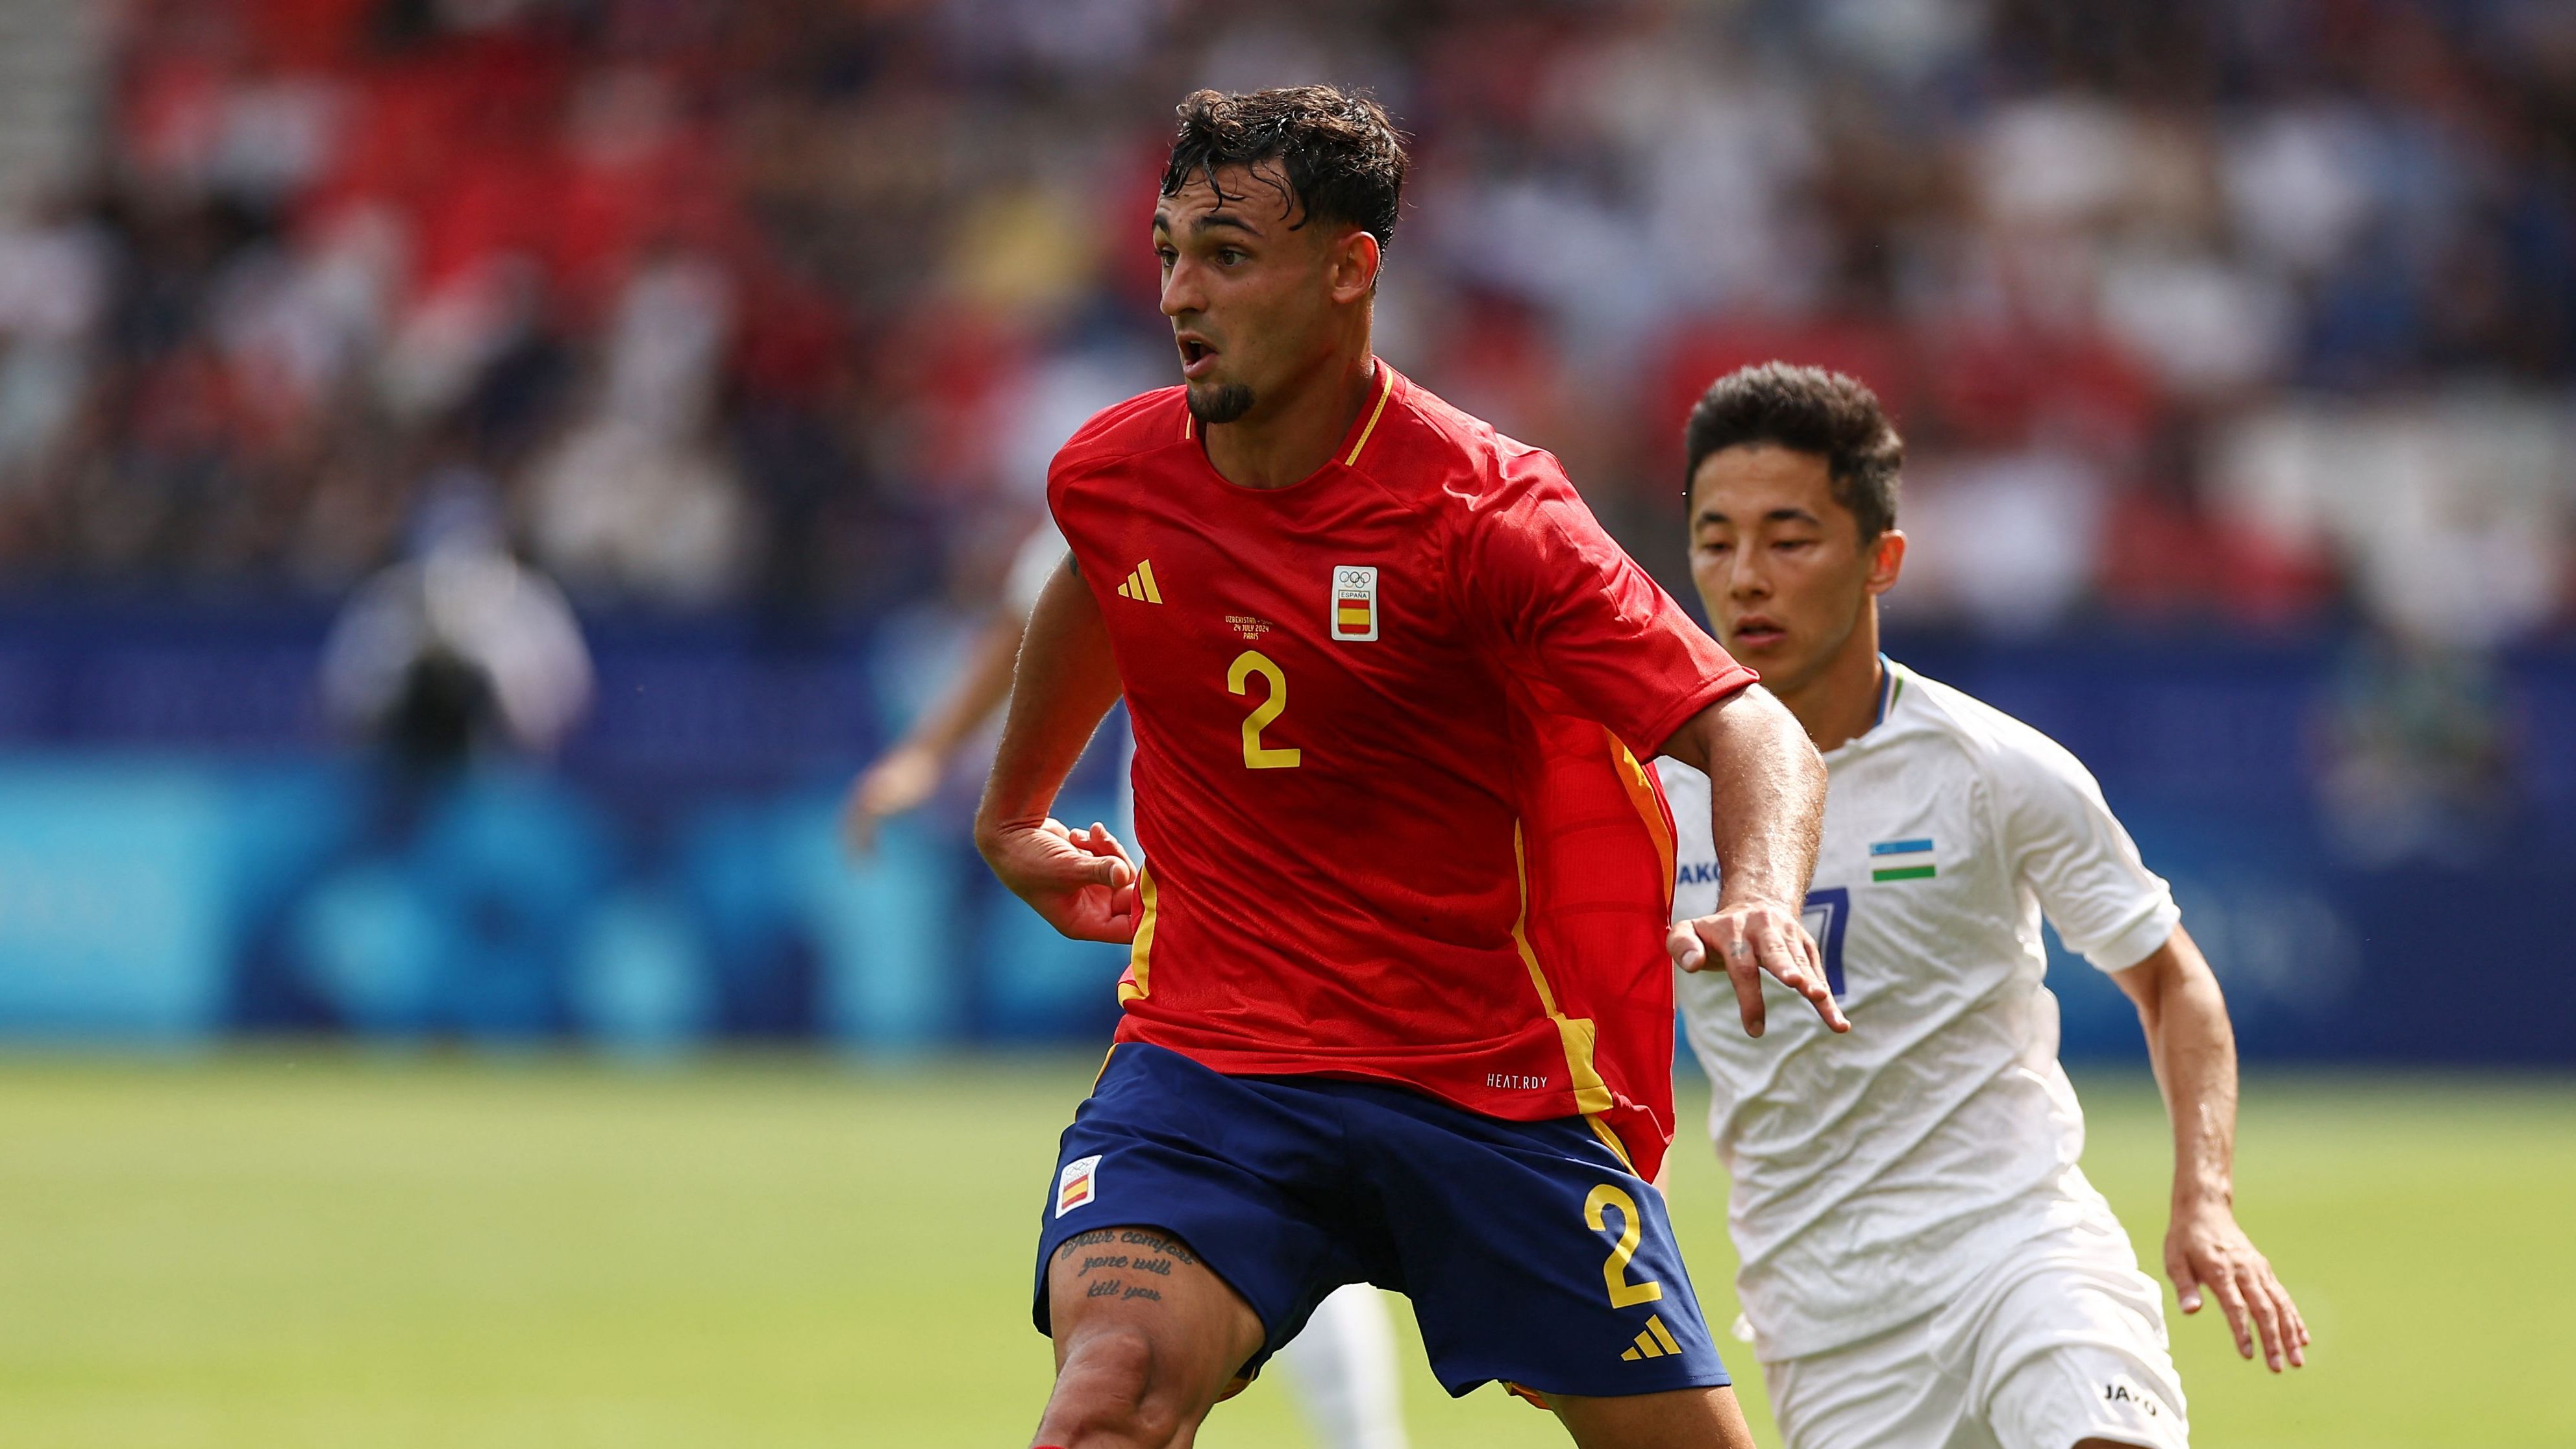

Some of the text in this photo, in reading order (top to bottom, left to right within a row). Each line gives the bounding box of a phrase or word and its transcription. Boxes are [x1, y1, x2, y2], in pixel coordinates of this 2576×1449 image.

[1225, 615, 1256, 624] UZBEKISTAN
[1228, 650, 1300, 769] 2
[1487, 1073, 1547, 1089] HEAT.RDY
[1584, 1183, 1663, 1309] 2
